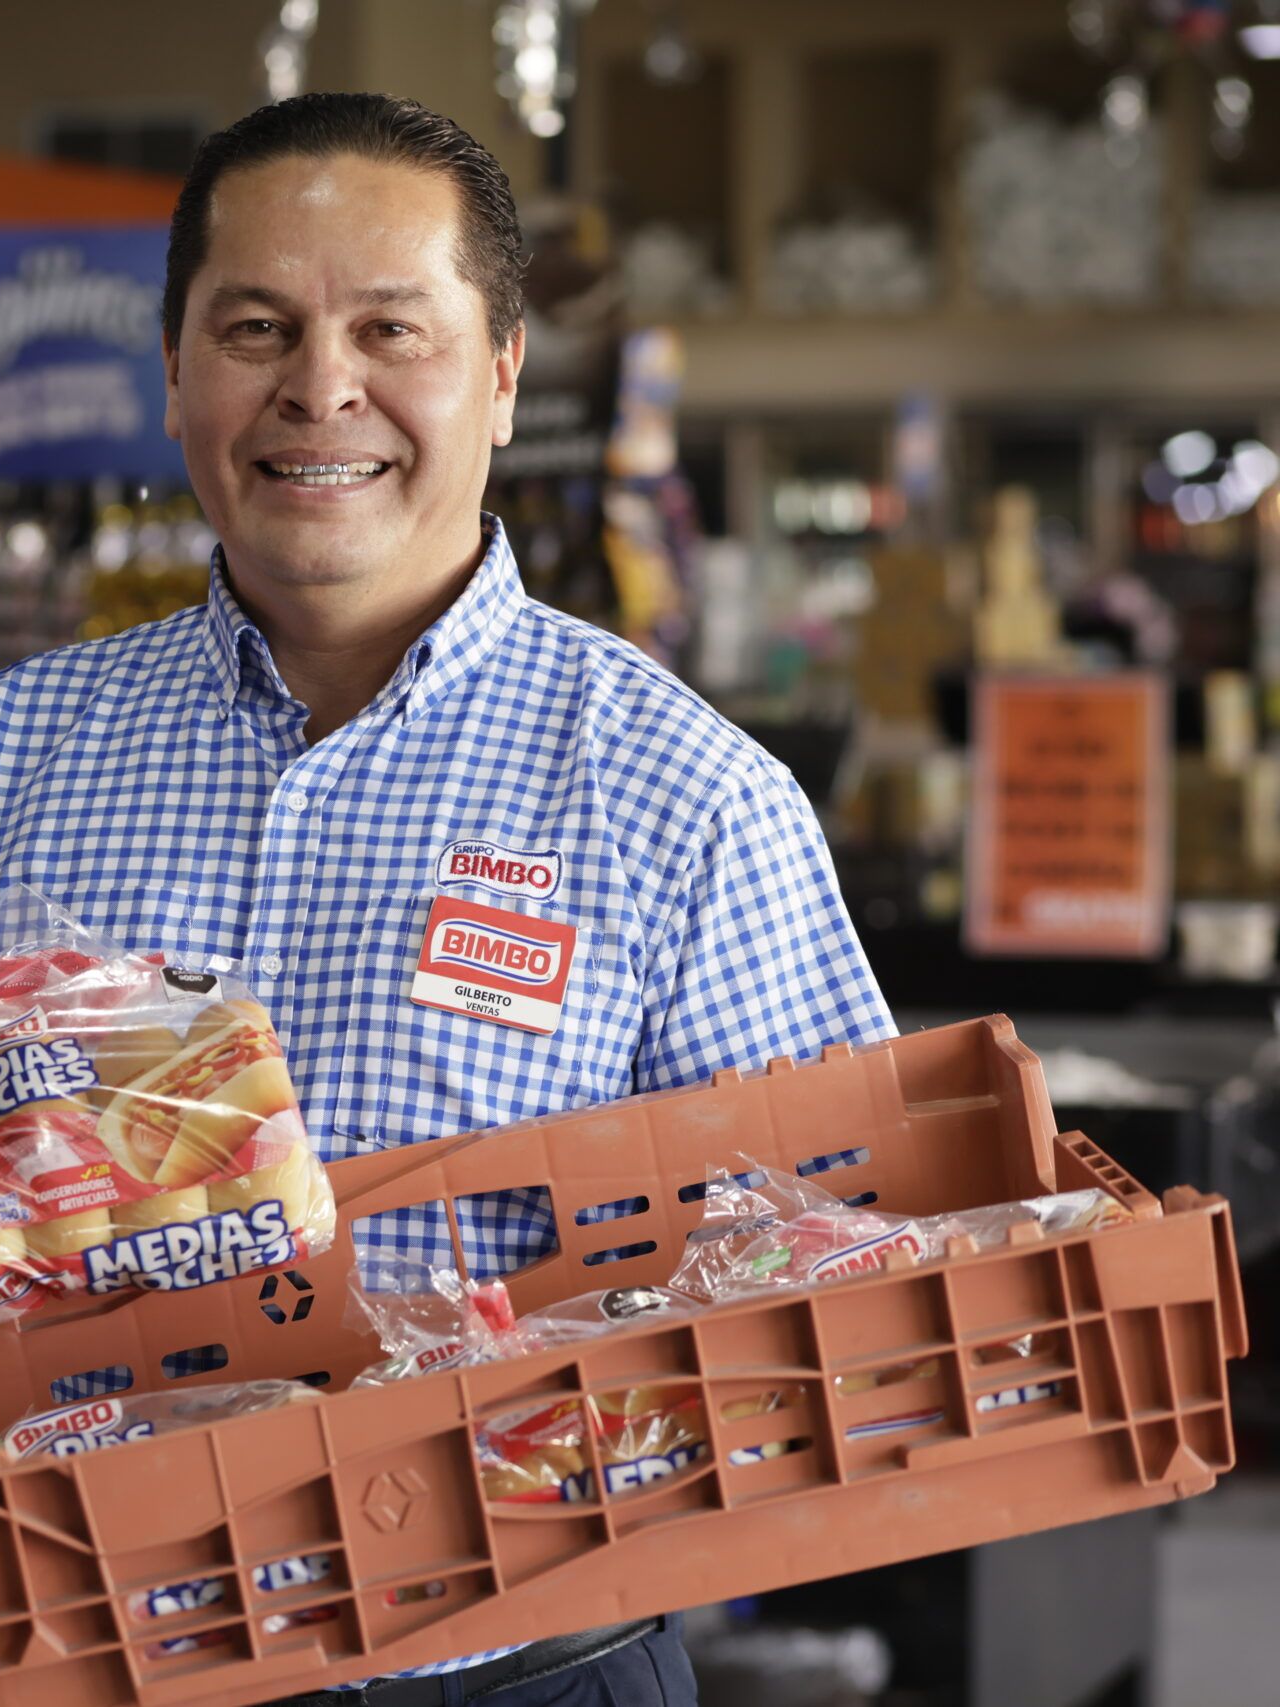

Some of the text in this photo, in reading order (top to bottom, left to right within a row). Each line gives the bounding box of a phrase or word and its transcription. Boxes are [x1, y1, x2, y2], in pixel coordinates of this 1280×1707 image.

[452, 845, 495, 857] GRUPO
[449, 853, 552, 889] BIMBO
[441, 927, 552, 976] BIMBO
[454, 985, 512, 1007] GILBERTO
[465, 1001, 500, 1017] VENTAS
[34, 1176, 115, 1204] CONSERVADORES
[58, 1188, 120, 1213] ARTIFICIALES
[87, 1202, 287, 1284] MEDIAS
[12, 1401, 115, 1453] BIMBO
